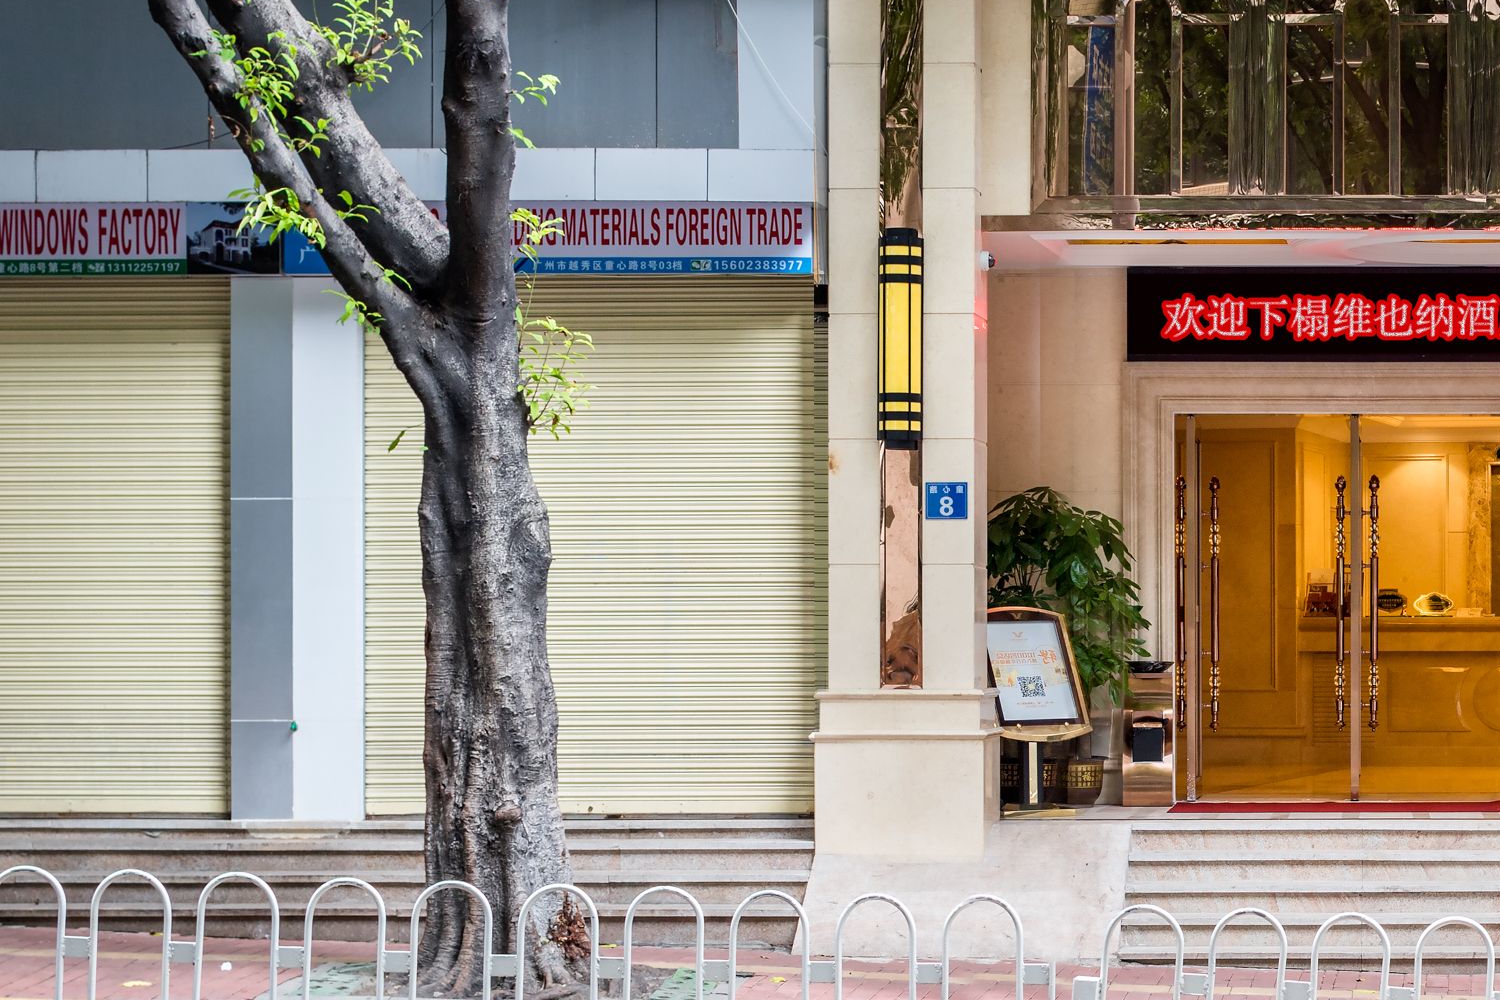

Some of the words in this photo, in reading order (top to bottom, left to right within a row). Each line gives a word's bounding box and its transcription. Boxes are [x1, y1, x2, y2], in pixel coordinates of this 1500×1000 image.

[0, 208, 89, 255] WINDOWS
[98, 208, 181, 255] FACTORY
[562, 208, 661, 246] MATERIALS
[666, 208, 741, 246] FOREIGN
[746, 208, 803, 246] TRADE
[108, 262, 180, 273] 13112257197
[714, 260, 803, 272] 15602383977
[939, 496, 954, 517] 8
